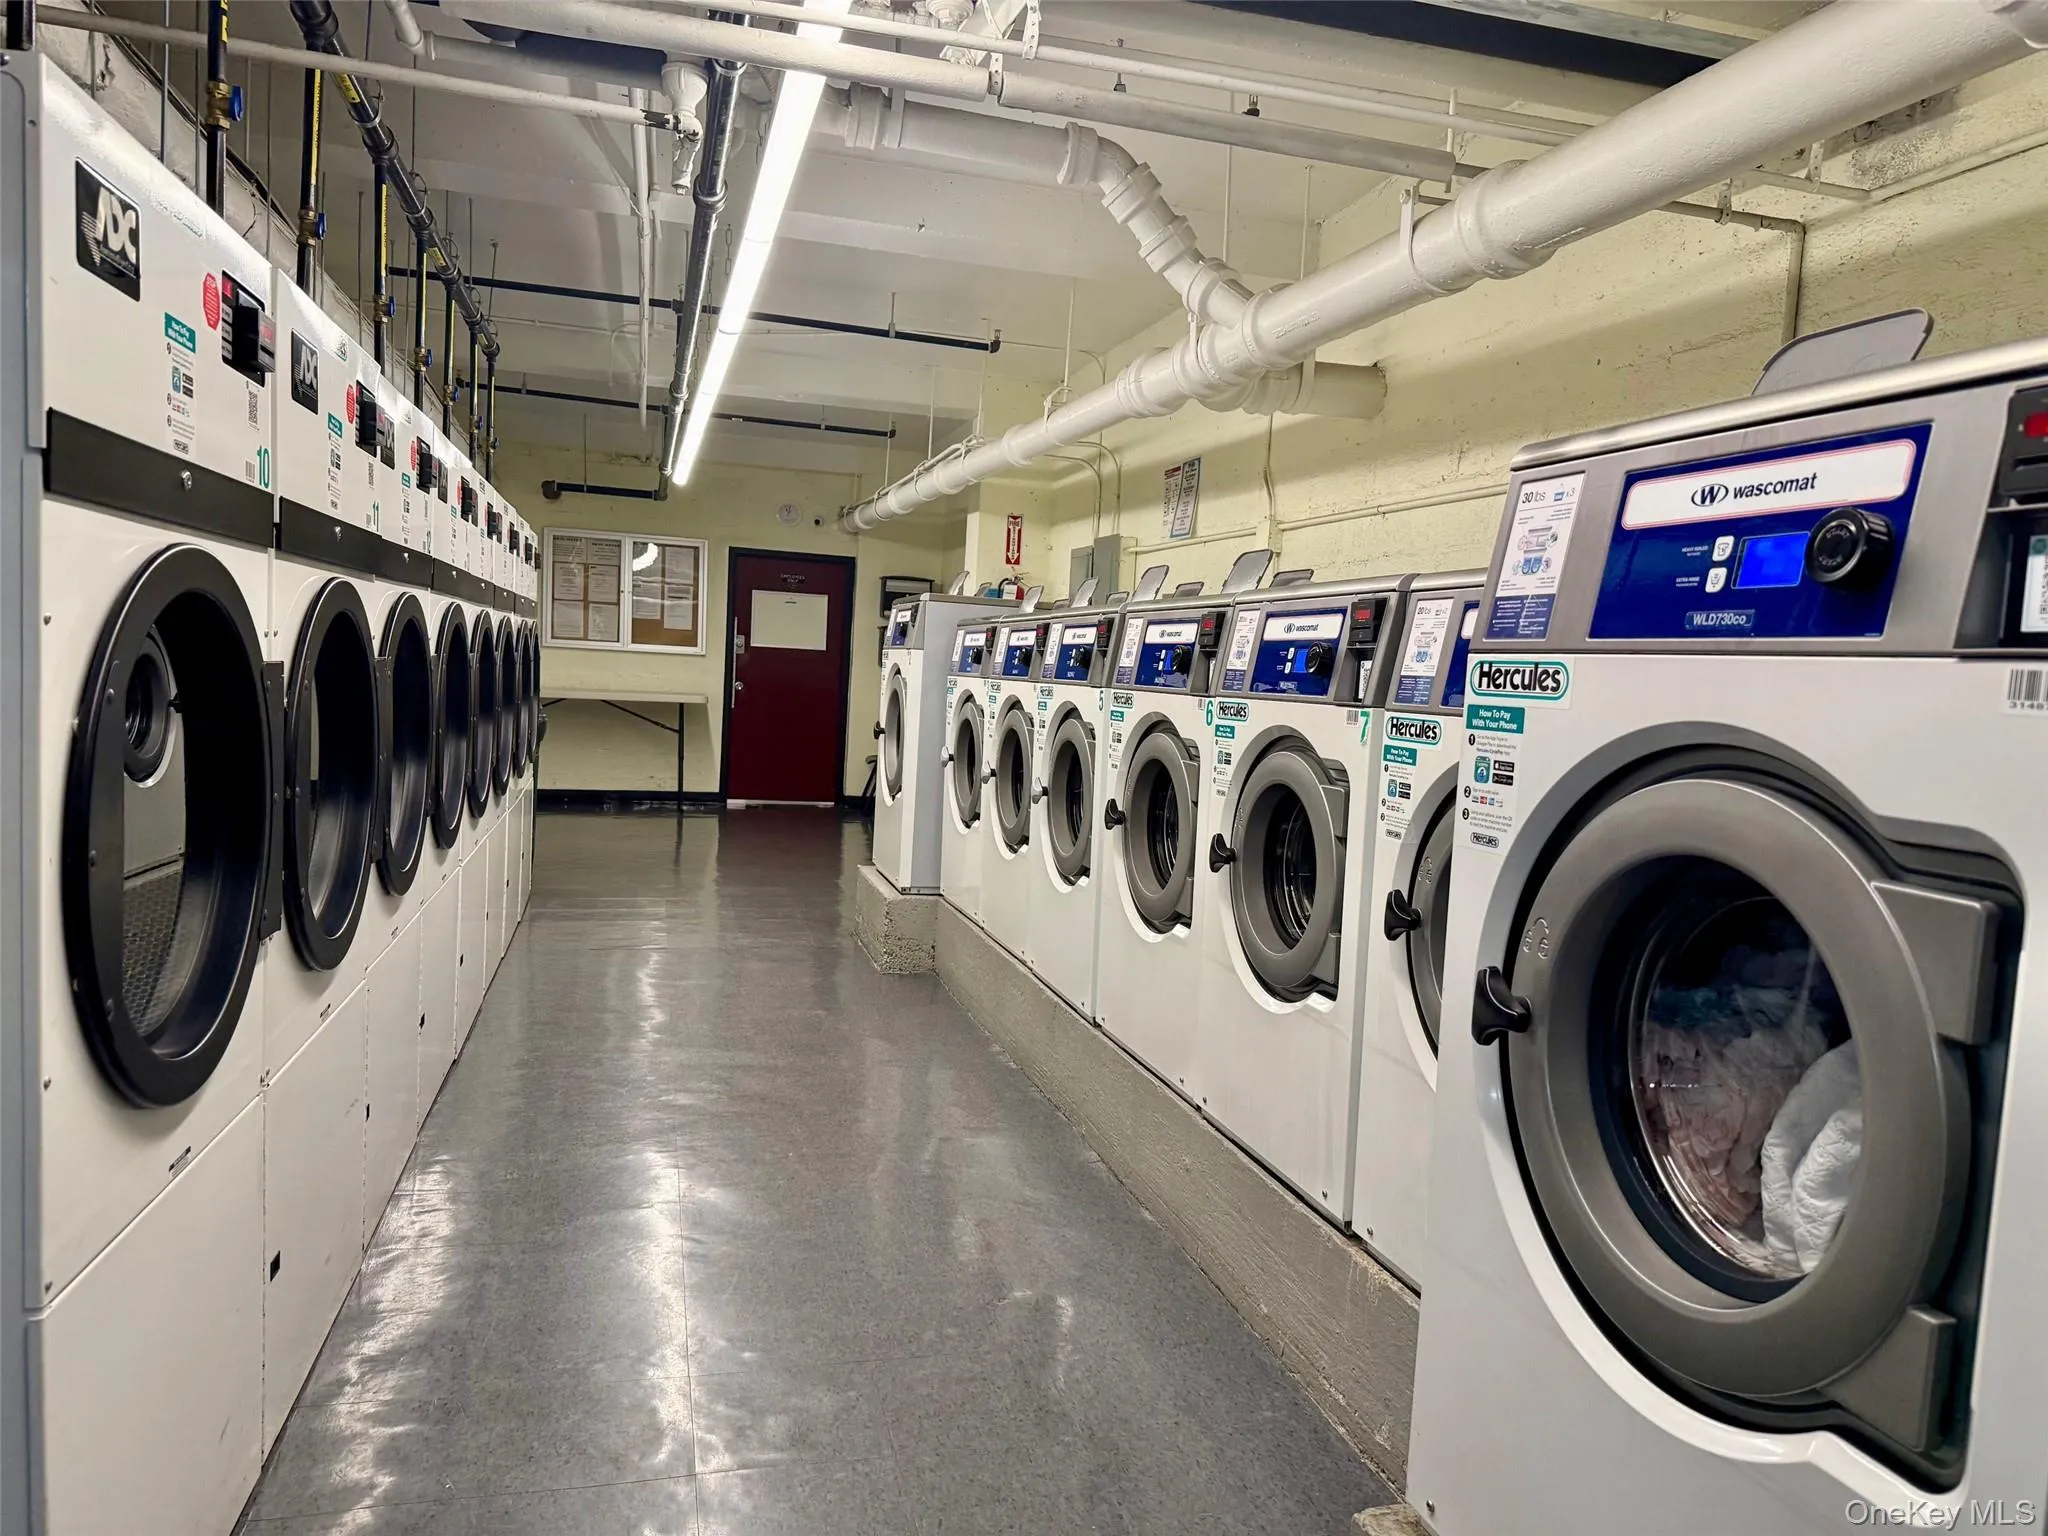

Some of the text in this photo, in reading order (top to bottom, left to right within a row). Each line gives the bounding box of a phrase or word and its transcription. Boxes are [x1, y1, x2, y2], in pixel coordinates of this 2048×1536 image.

[257, 445, 270, 489] 10
[1733, 472, 1818, 500] wascomat
[1522, 491, 1534, 504] 30
[1692, 612, 1747, 627] WLD730co
[1478, 661, 1561, 693] Hercules
[1206, 700, 1214, 727] 6
[1218, 701, 1247, 718] Hercules
[1479, 709, 1511, 721] How To Pay
[1360, 710, 1370, 743] 7
[1390, 717, 1438, 740] Hercules
[1472, 718, 1518, 730] With Your Phone
[1472, 832, 1497, 846] Hercules
